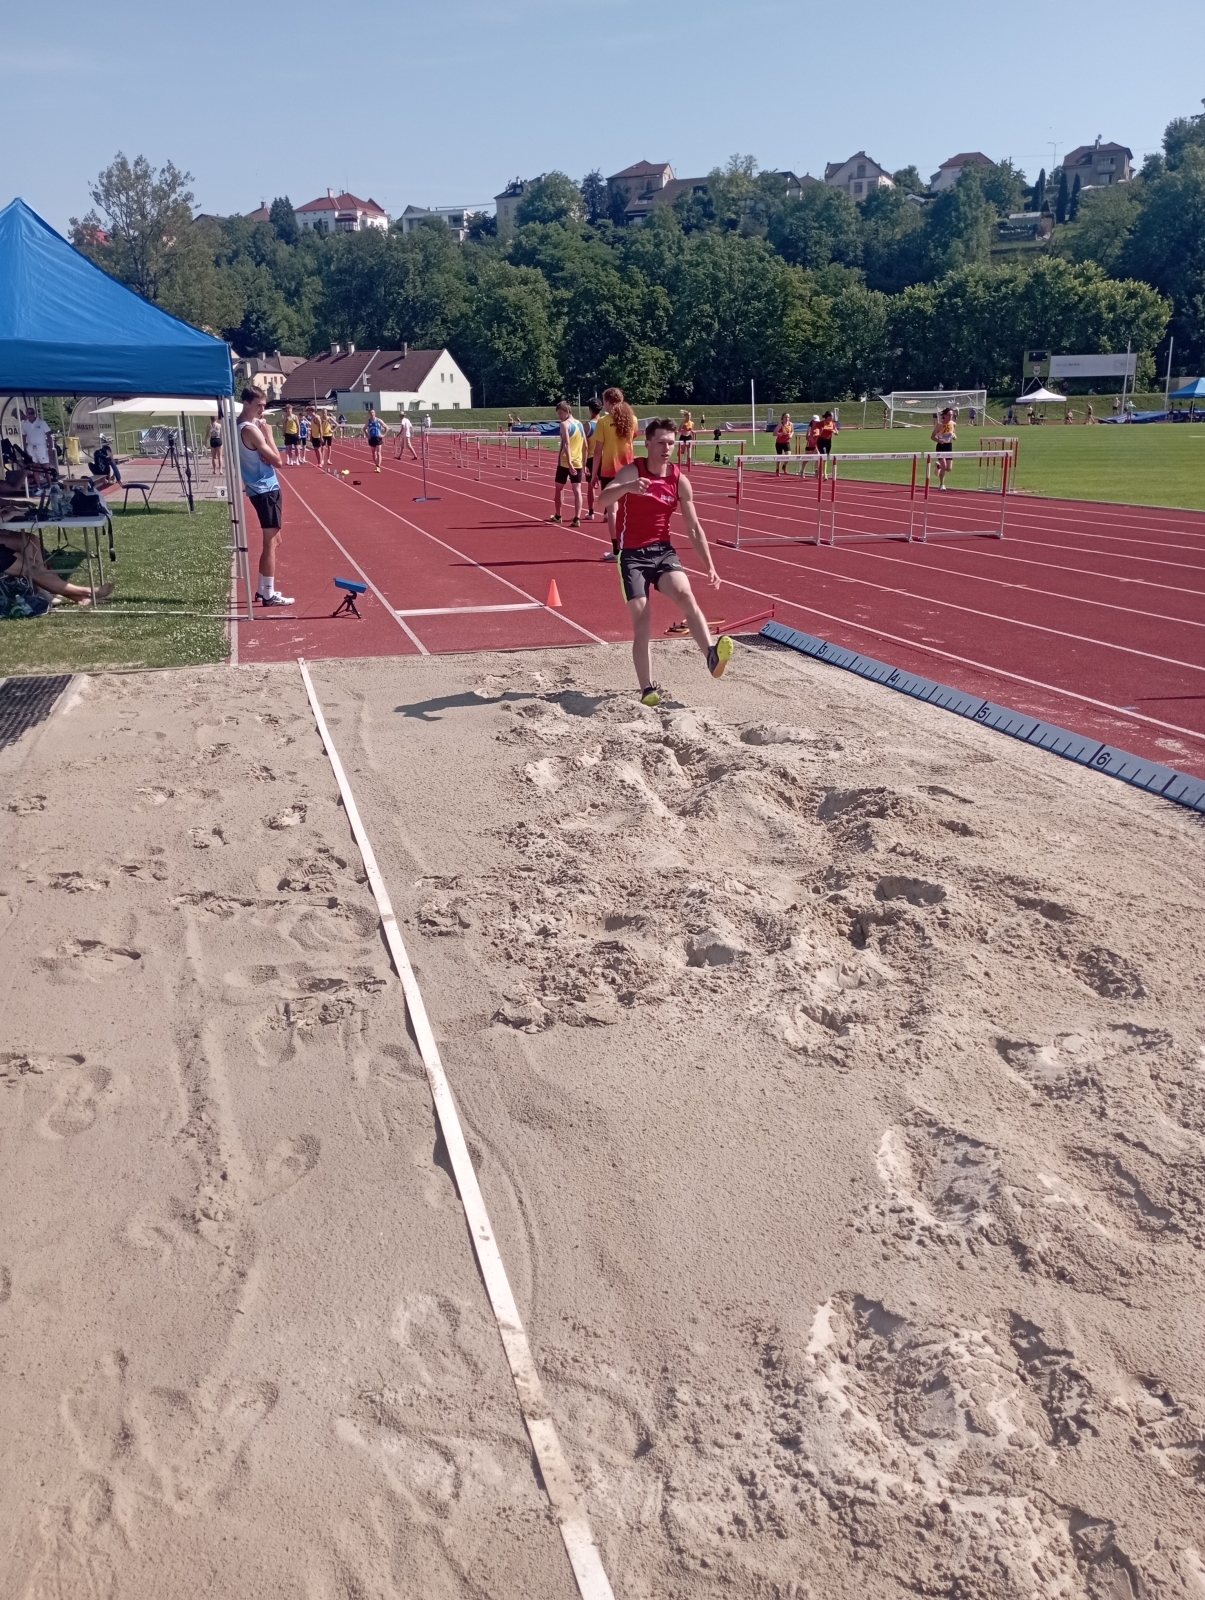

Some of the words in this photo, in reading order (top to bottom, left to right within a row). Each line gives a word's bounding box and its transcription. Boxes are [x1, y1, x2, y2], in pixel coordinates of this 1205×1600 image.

[761, 624, 770, 632] 2
[819, 645, 828, 654] 3
[891, 673, 900, 683] 4
[977, 706, 990, 719] 5
[1096, 752, 1110, 765] 6
